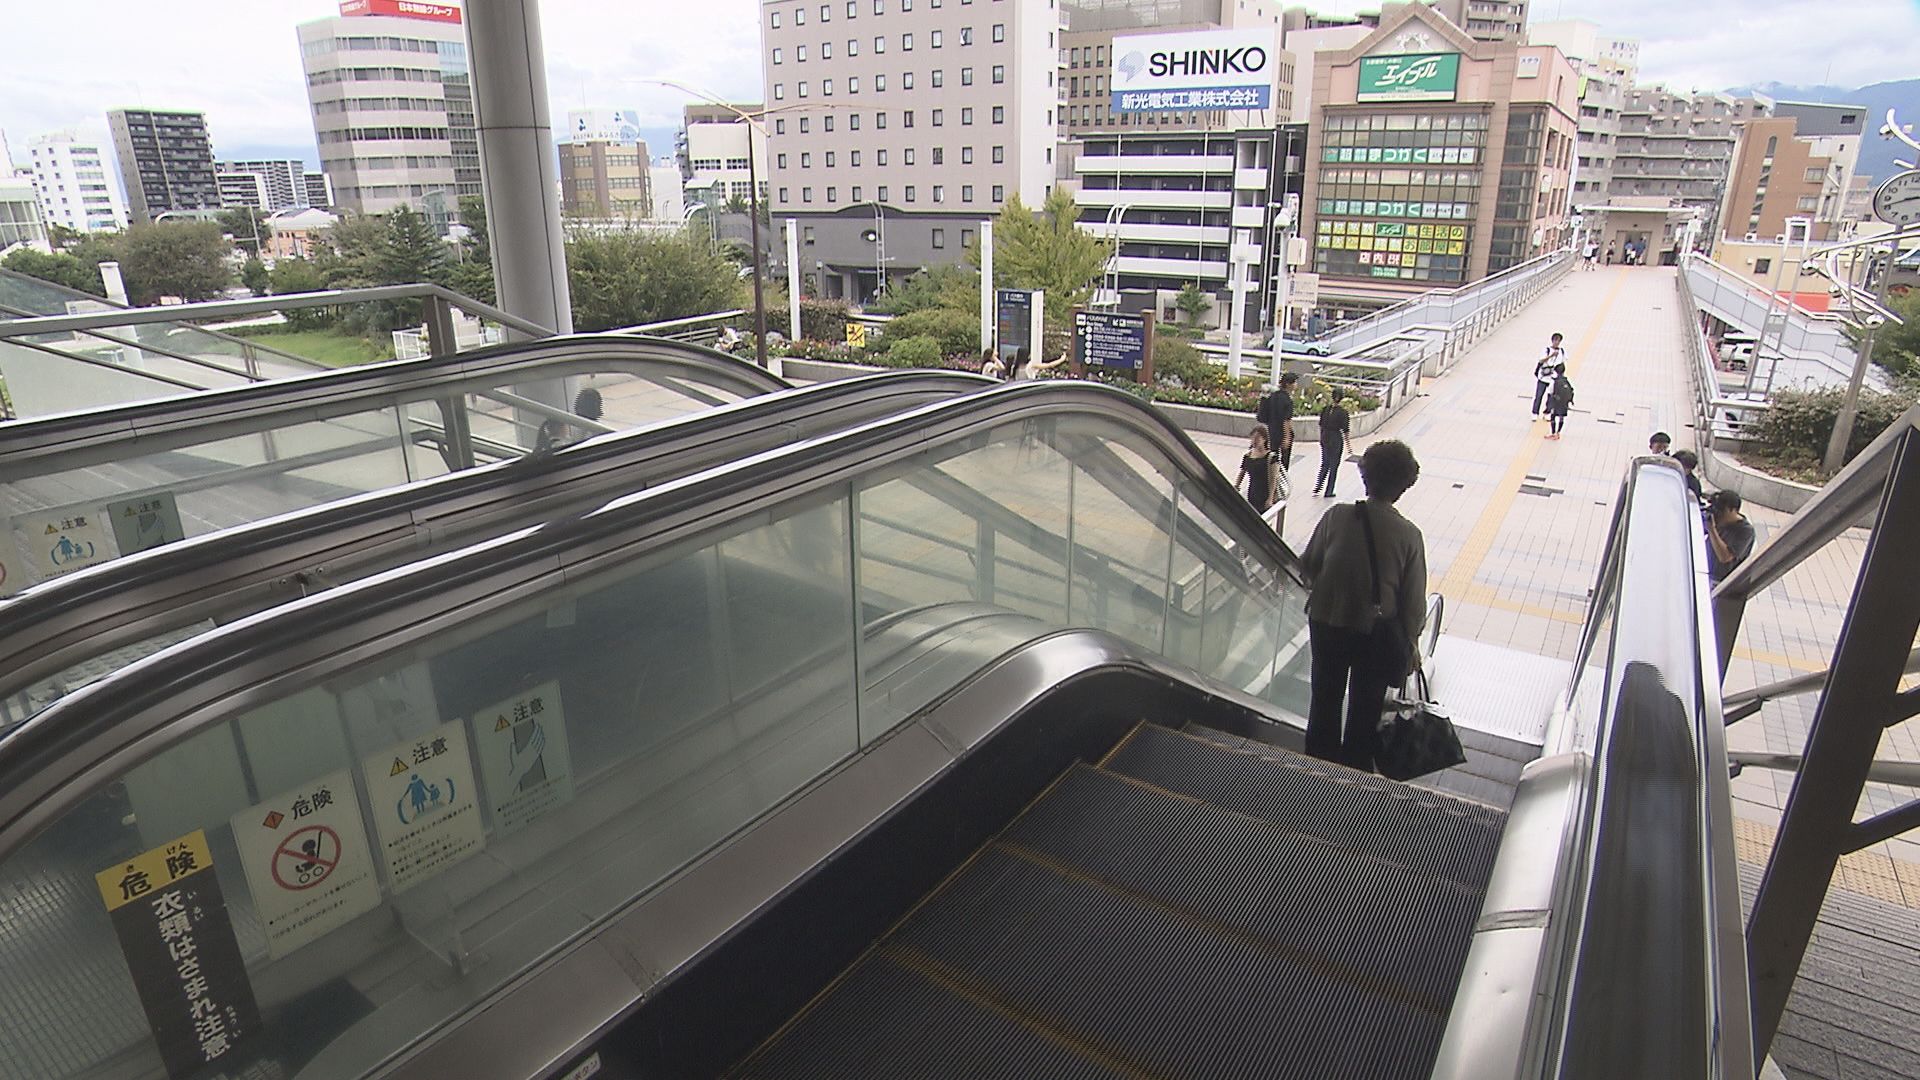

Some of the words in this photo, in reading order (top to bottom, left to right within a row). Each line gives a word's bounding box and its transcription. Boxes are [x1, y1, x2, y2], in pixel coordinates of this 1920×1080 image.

[1149, 47, 1266, 77] SHINKO
[1374, 56, 1441, 86] エイブル
[1121, 89, 1260, 110] 新光電気工業株式会社
[61, 515, 88, 531] 注意
[513, 697, 545, 722] 注意
[412, 736, 448, 765] 注意
[291, 789, 334, 820] 危険
[118, 849, 198, 900] 危険
[152, 889, 231, 1062] 衣類はさまれ注意
